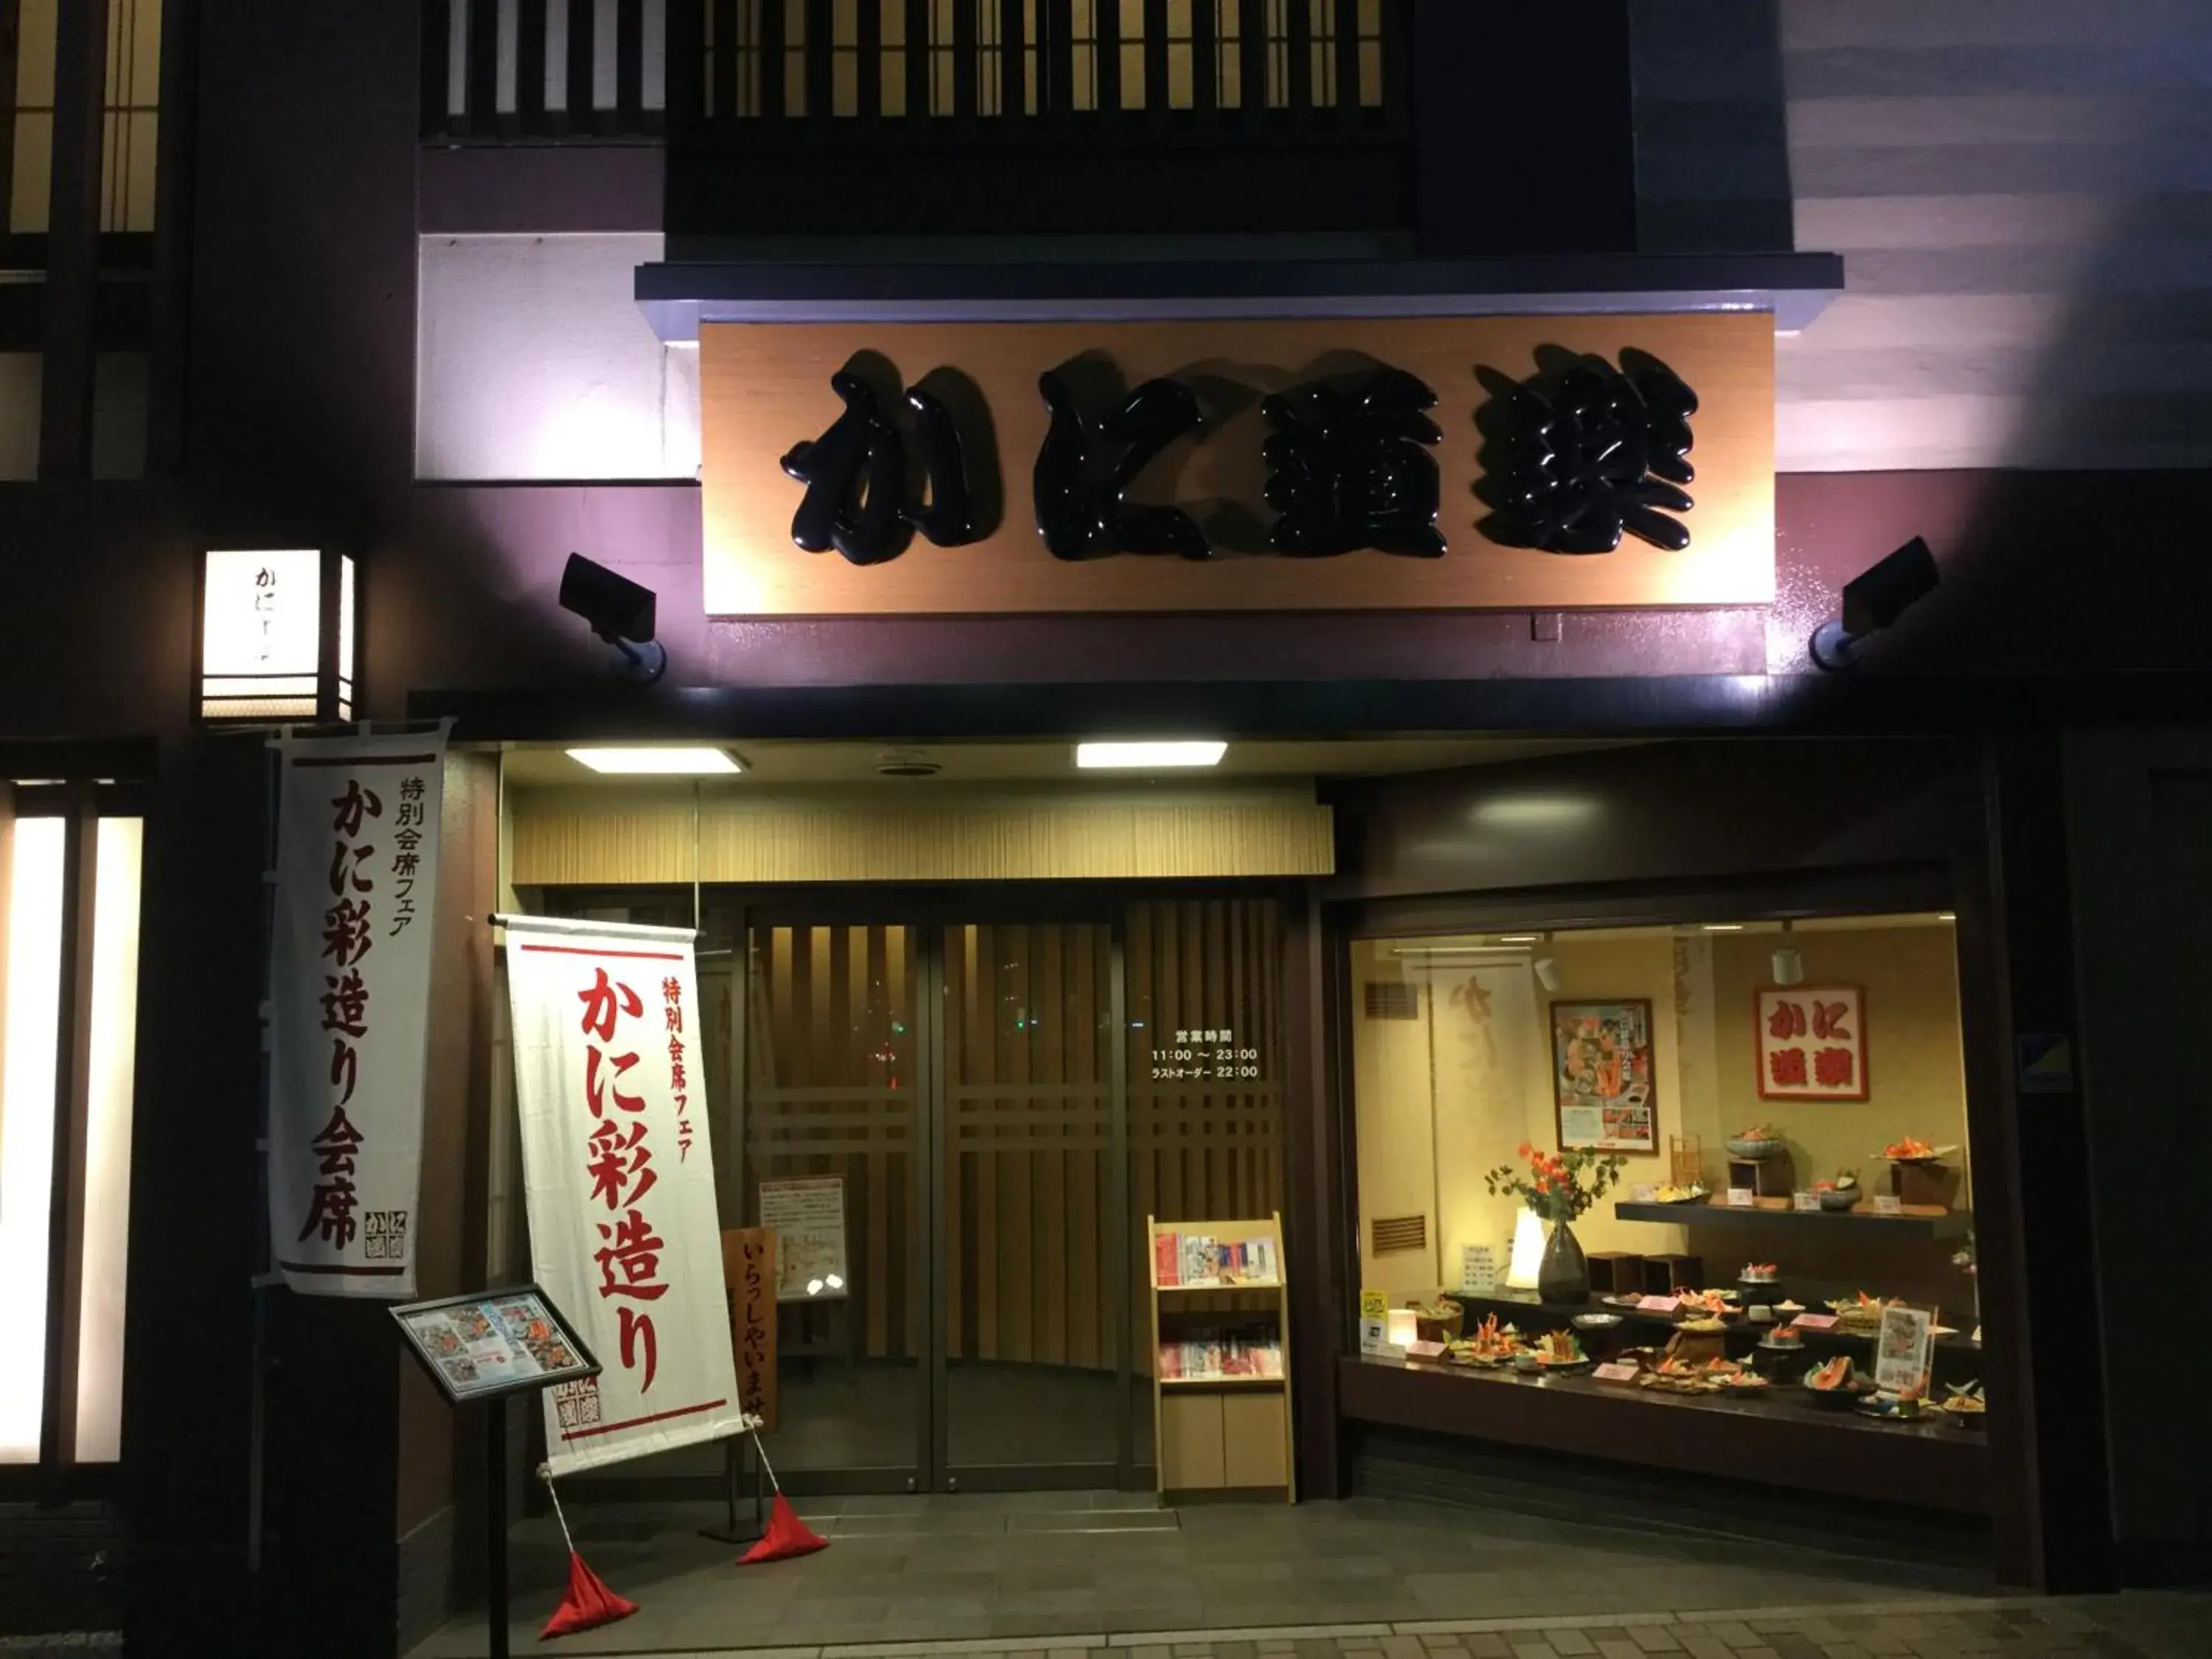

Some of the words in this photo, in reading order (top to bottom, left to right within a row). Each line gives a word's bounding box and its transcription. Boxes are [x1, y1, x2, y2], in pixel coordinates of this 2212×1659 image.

[389, 776, 425, 937] 特別会席フェア
[297, 779, 383, 1251] かに彩造り会席
[661, 976, 694, 1164] 特別会席フェア
[1151, 1067, 1211, 1079] ラストオーダー
[1216, 1065, 1259, 1078] 22:00
[1152, 1049, 1192, 1061] 11:00
[1216, 1048, 1258, 1060] 23:00
[1175, 1029, 1233, 1043] 営業時間
[577, 966, 669, 1395] かに彩造り
